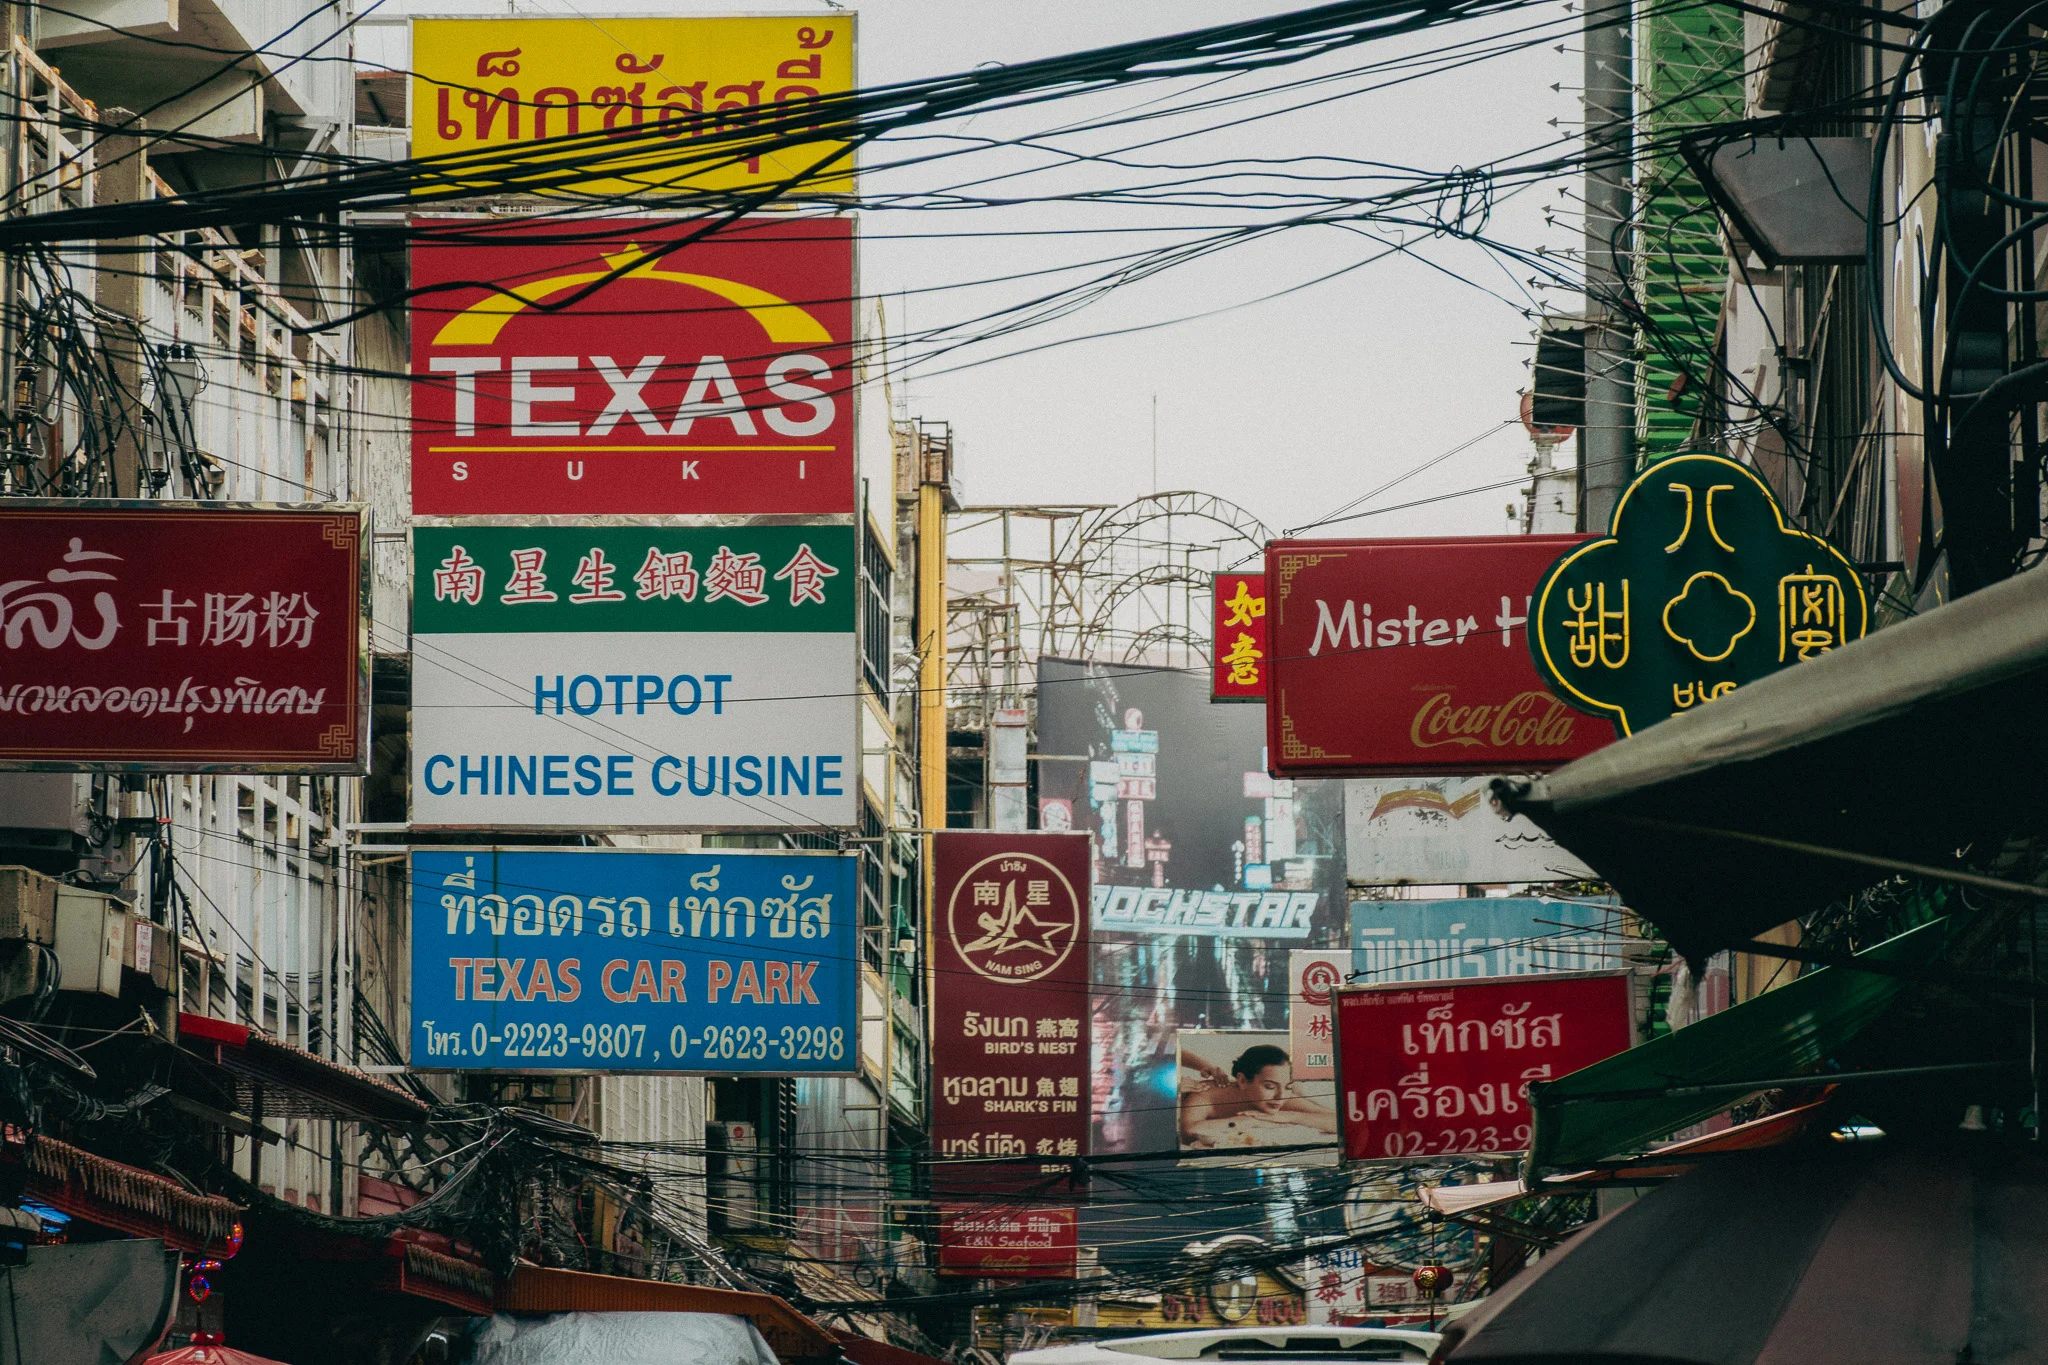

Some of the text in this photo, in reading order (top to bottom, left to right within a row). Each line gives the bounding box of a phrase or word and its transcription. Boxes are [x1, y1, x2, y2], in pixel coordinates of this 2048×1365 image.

[429, 354, 836, 437] TEXAS
[1221, 581, 1266, 685] 如意
[1308, 599, 1479, 657] Mister
[534, 674, 732, 716] HOTPOT
[1410, 691, 1576, 748] Coca-Cola
[423, 754, 843, 797] CHINESE CUISINE
[440, 856, 833, 940] ที่จอดรถ เท็กซัส
[1094, 884, 1320, 929] OCKSTAR
[449, 957, 820, 1005] TEXAS CAR PARK
[985, 959, 1044, 975] NAM SING
[670, 1025, 845, 1061] 0-2623-3298
[985, 1042, 1078, 1055] BIRD'S NEST
[1402, 1001, 1563, 1056] เท็กซัส
[1306, 1054, 1328, 1066] LIM
[984, 1100, 1077, 1113] SHARK'S FIN
[998, 1235, 1053, 1250] Seafood
